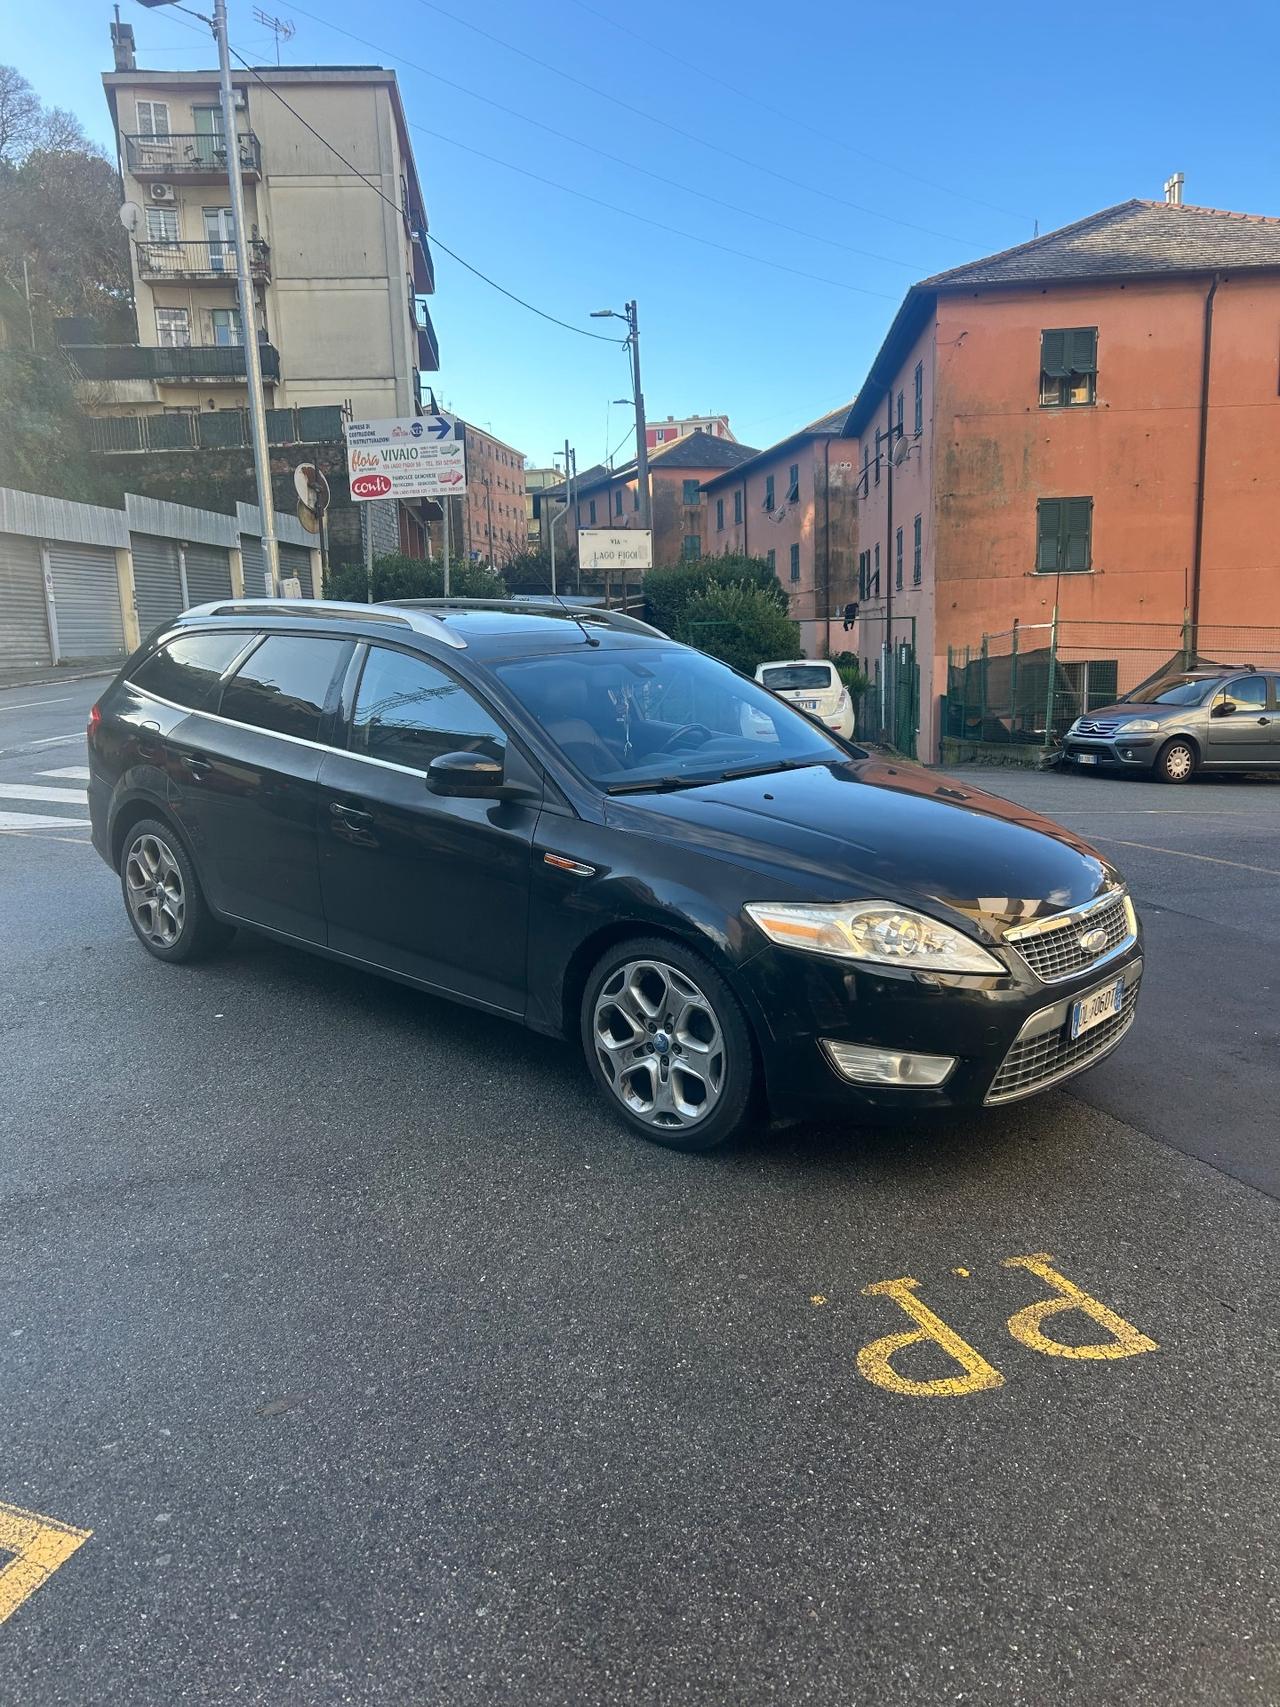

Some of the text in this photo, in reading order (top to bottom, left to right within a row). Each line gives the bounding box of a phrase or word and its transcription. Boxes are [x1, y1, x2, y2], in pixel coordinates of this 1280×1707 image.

[381, 447, 418, 461] VIVAIO
[354, 476, 389, 494] conti
[593, 551, 615, 560] LAGO
